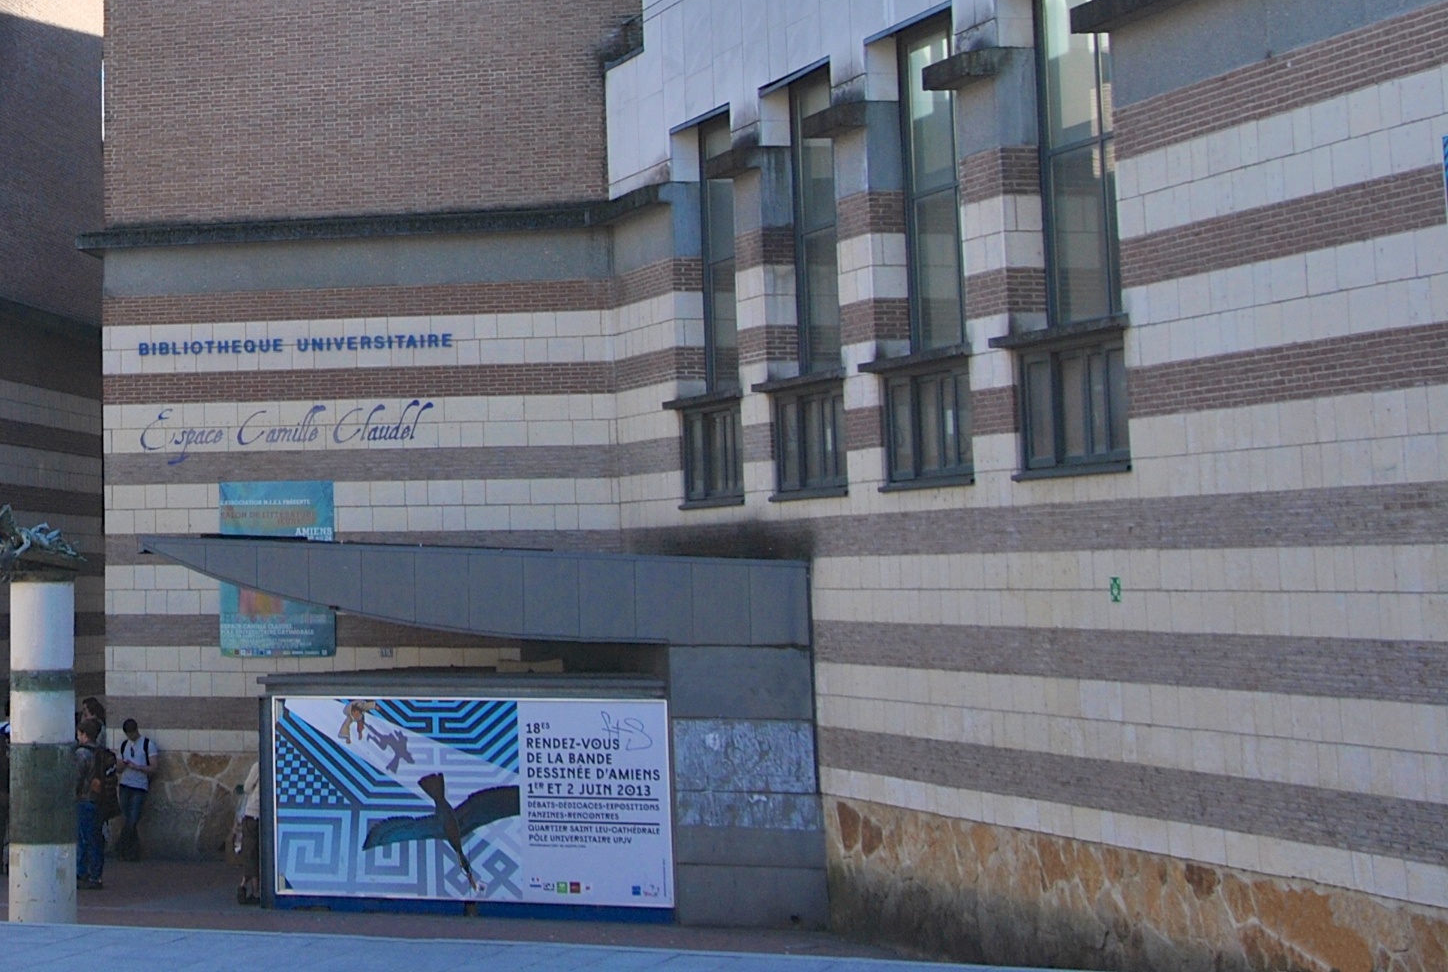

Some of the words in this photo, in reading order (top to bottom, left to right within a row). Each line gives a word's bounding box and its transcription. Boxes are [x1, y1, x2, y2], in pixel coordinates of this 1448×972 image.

[138, 338, 284, 356] BIBLIOTHEQUE
[296, 333, 453, 352] UNIVERSITAIRE
[140, 408, 224, 465] Espace
[237, 405, 326, 446] Camille
[332, 399, 434, 444] Claudel
[294, 527, 333, 536] AMIENS
[526, 737, 620, 750] RENDEZ-VOUS
[527, 752, 542, 764] DE
[548, 753, 564, 764] LA
[569, 753, 612, 765] BANDE
[527, 765, 591, 779] DESSINÉE
[596, 769, 661, 781] D'AMIENS
[528, 782, 544, 794] 1ER
[548, 783, 562, 795] ET
[567, 784, 574, 795] 2
[579, 784, 612, 795] JUIN
[617, 785, 651, 797] 2013
[528, 825, 568, 833] QUARTIER
[529, 833, 548, 842] PÔLE
[550, 835, 611, 844] UNIVERSITAIRE
[613, 836, 632, 844] UPJV
